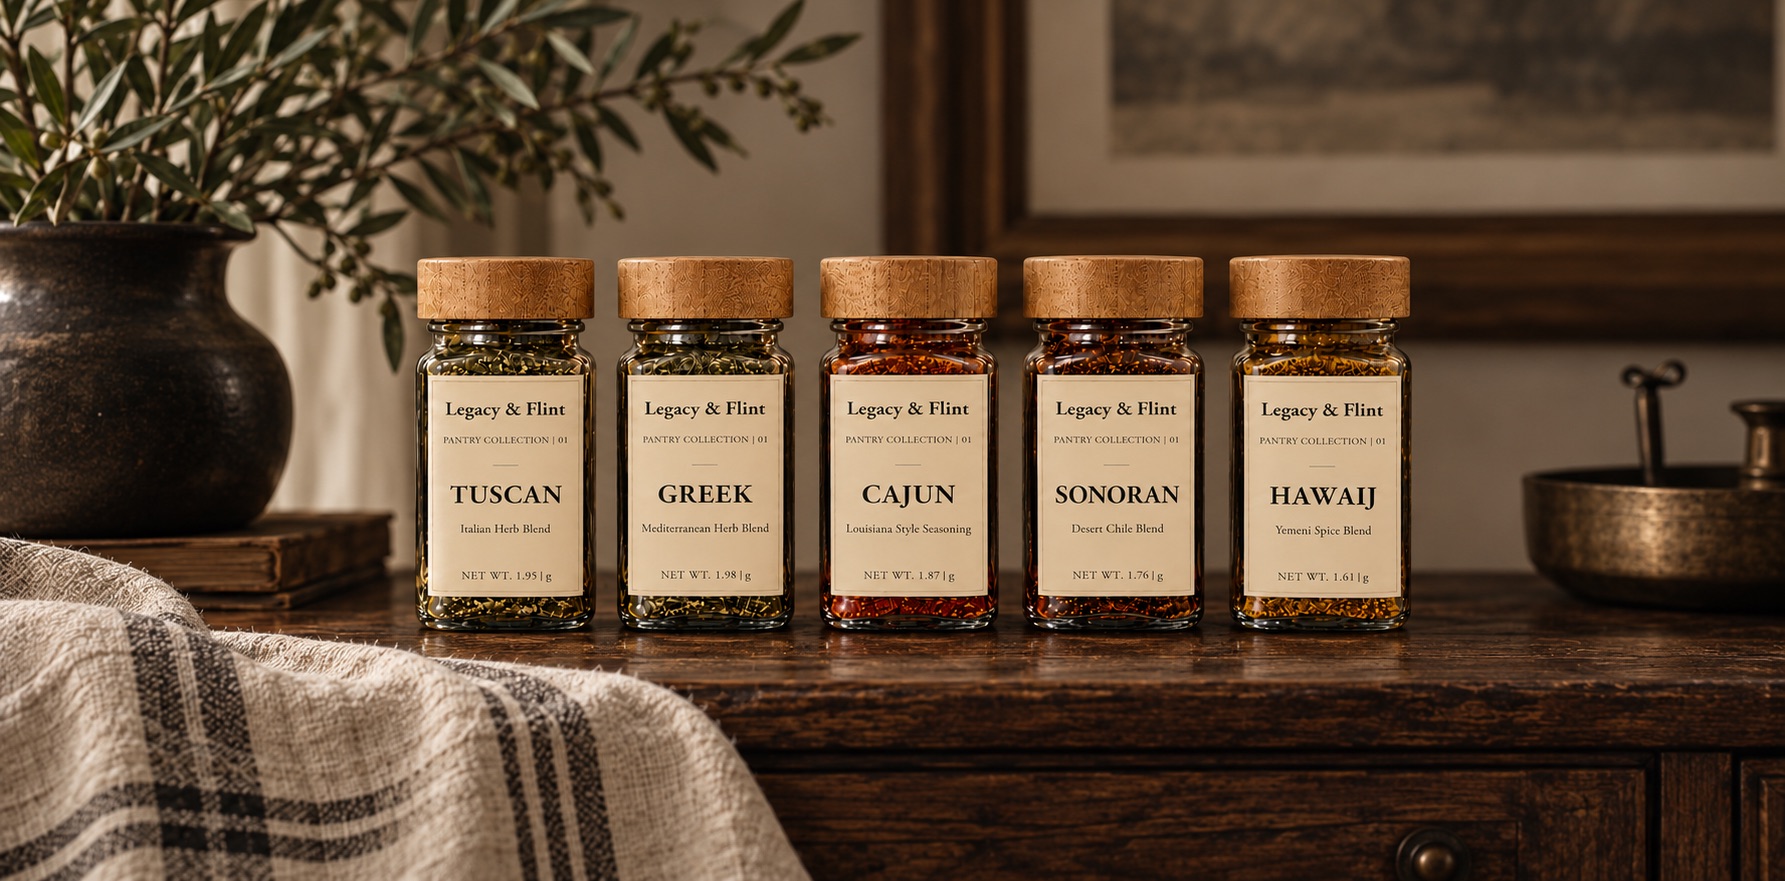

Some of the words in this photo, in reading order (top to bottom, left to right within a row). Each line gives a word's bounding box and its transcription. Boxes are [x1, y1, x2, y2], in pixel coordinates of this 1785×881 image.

[445, 401, 502, 421] Legacy
[505, 401, 522, 417] &
[526, 400, 566, 416] Flint
[644, 401, 701, 421] Legacy
[704, 401, 722, 416] &
[725, 400, 766, 416] Flint
[847, 400, 904, 421] Legacy
[907, 401, 924, 416] &
[928, 400, 970, 416] Flint
[1055, 400, 1113, 421] Legacy
[1116, 401, 1133, 416] &
[1137, 400, 1178, 416] Flint
[1261, 401, 1319, 422] Legacy
[1322, 402, 1340, 417] &
[1343, 402, 1384, 417] Flint
[443, 435, 482, 445] PANTRY
[483, 435, 550, 445] COLLECTION
[557, 436, 568, 444] 01
[642, 435, 681, 444] PANTRY
[682, 435, 749, 444] COLLECTION
[757, 435, 768, 444] 01
[845, 435, 884, 444] PANTRY
[885, 435, 953, 444] COLLECTION
[961, 435, 972, 444] 01
[1053, 435, 1093, 444] PANTRY
[1094, 435, 1161, 445] COLLECTION
[1169, 436, 1179, 444] 01
[1259, 436, 1299, 446] PANTRY
[1300, 437, 1368, 446] COLLECTION
[1375, 437, 1386, 446] 01
[449, 484, 563, 505] TUSCAN
[657, 484, 754, 504] GREEK
[861, 484, 956, 509] CAJUN
[1055, 484, 1180, 505] SONORAN
[1269, 485, 1377, 511] HAWAIJ
[460, 523, 492, 534] Italian
[494, 523, 520, 534] Herb
[522, 523, 551, 534] Blend
[641, 523, 711, 534] Mediterranean
[713, 522, 739, 534] Herb
[741, 522, 770, 533] Blend
[846, 523, 893, 534] Louisiana
[895, 523, 920, 537] Style
[922, 523, 972, 537] Seasoning
[1071, 523, 1103, 534] Desert
[1105, 523, 1133, 534] Chile
[1135, 523, 1164, 534] Blend
[1275, 524, 1312, 536] Yemeni
[1314, 525, 1341, 539] Spice
[1342, 524, 1372, 536] Blend
[461, 570, 487, 581] NET
[489, 571, 514, 581] WT.
[660, 570, 686, 580] NET
[688, 570, 712, 580] WT.
[863, 570, 889, 580] NET
[891, 570, 916, 580] WT.
[1072, 570, 1098, 580] NET
[1101, 570, 1125, 580] WT.
[1277, 571, 1304, 582] NET
[1306, 572, 1330, 582] WT.
